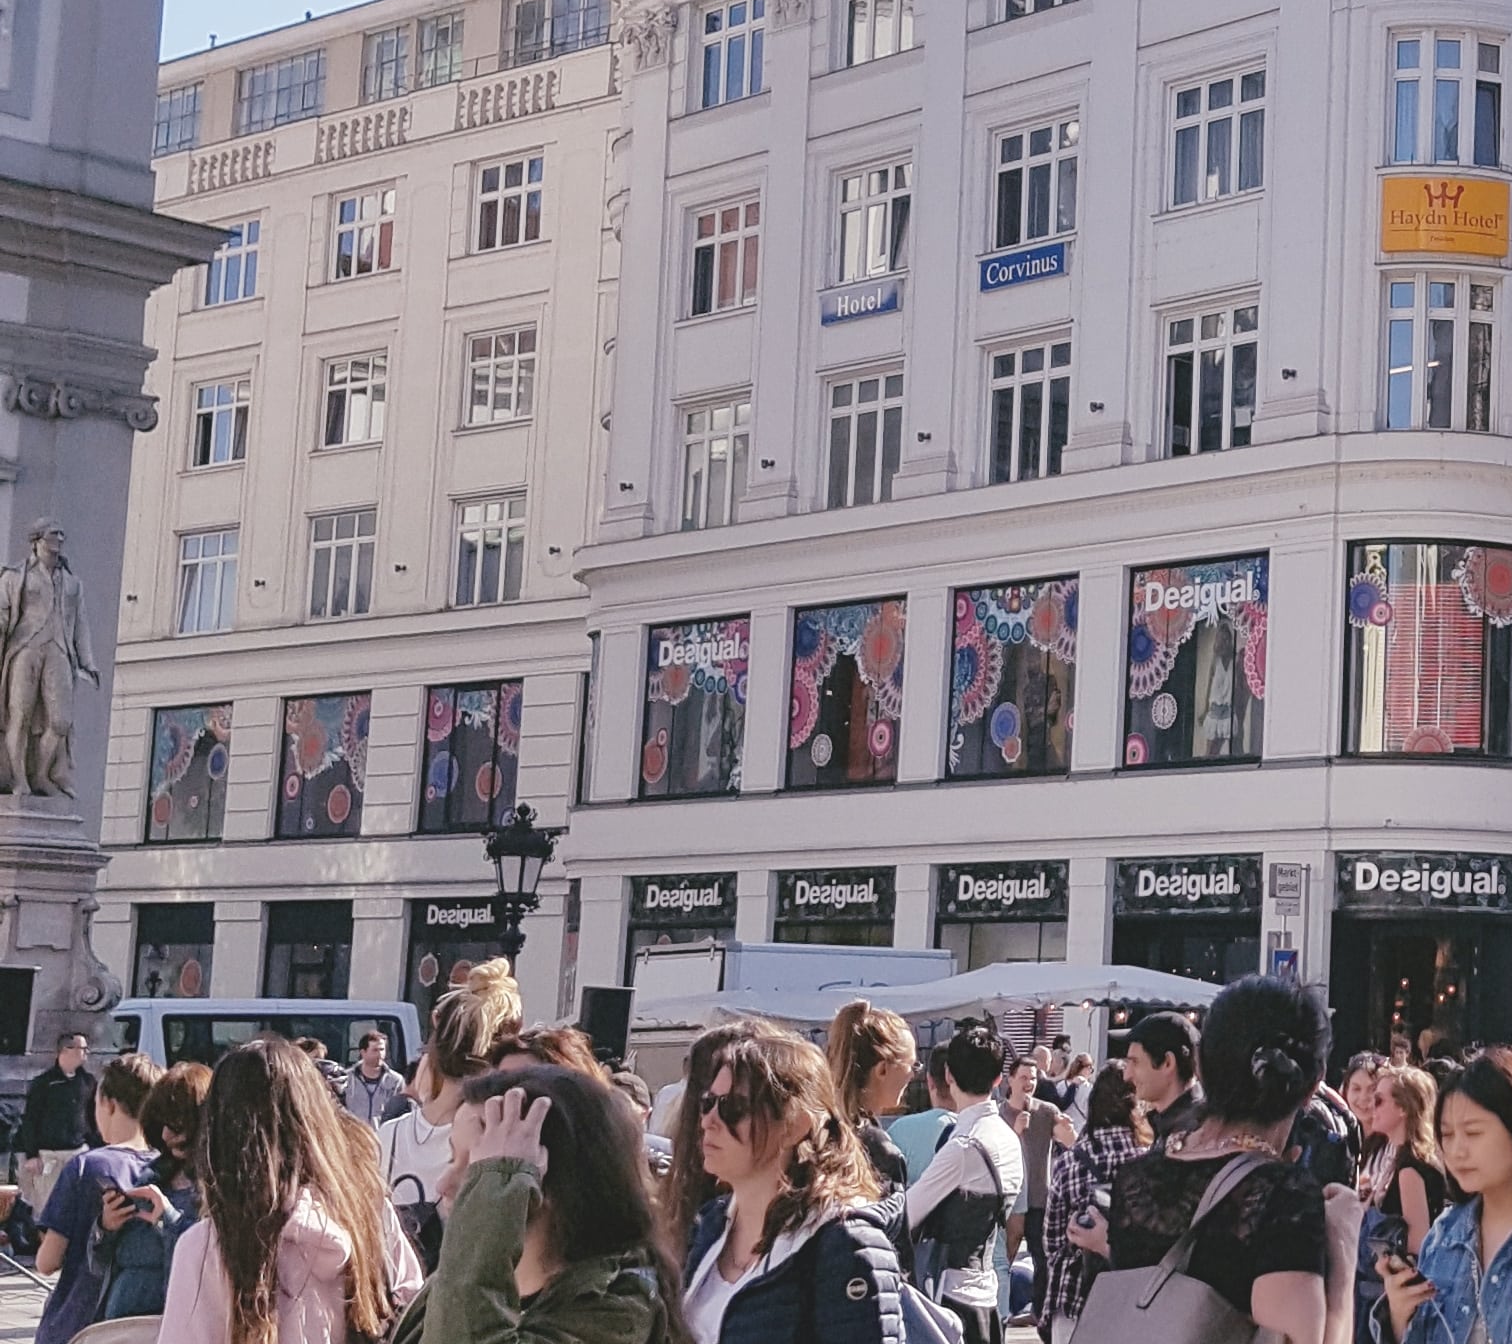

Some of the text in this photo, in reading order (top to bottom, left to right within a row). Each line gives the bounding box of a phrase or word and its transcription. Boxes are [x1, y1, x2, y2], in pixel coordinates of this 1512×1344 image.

[1390, 209, 1499, 231] Haydn Hotel
[986, 254, 1058, 286] Corvinus
[837, 287, 882, 318] Hotel
[794, 878, 873, 910] Desigual
[957, 872, 1043, 907] Desigual
[1138, 867, 1235, 901] Desigual
[1355, 861, 1499, 899] Desigual
[645, 881, 718, 913] Desigual
[426, 903, 492, 929] Desigual
